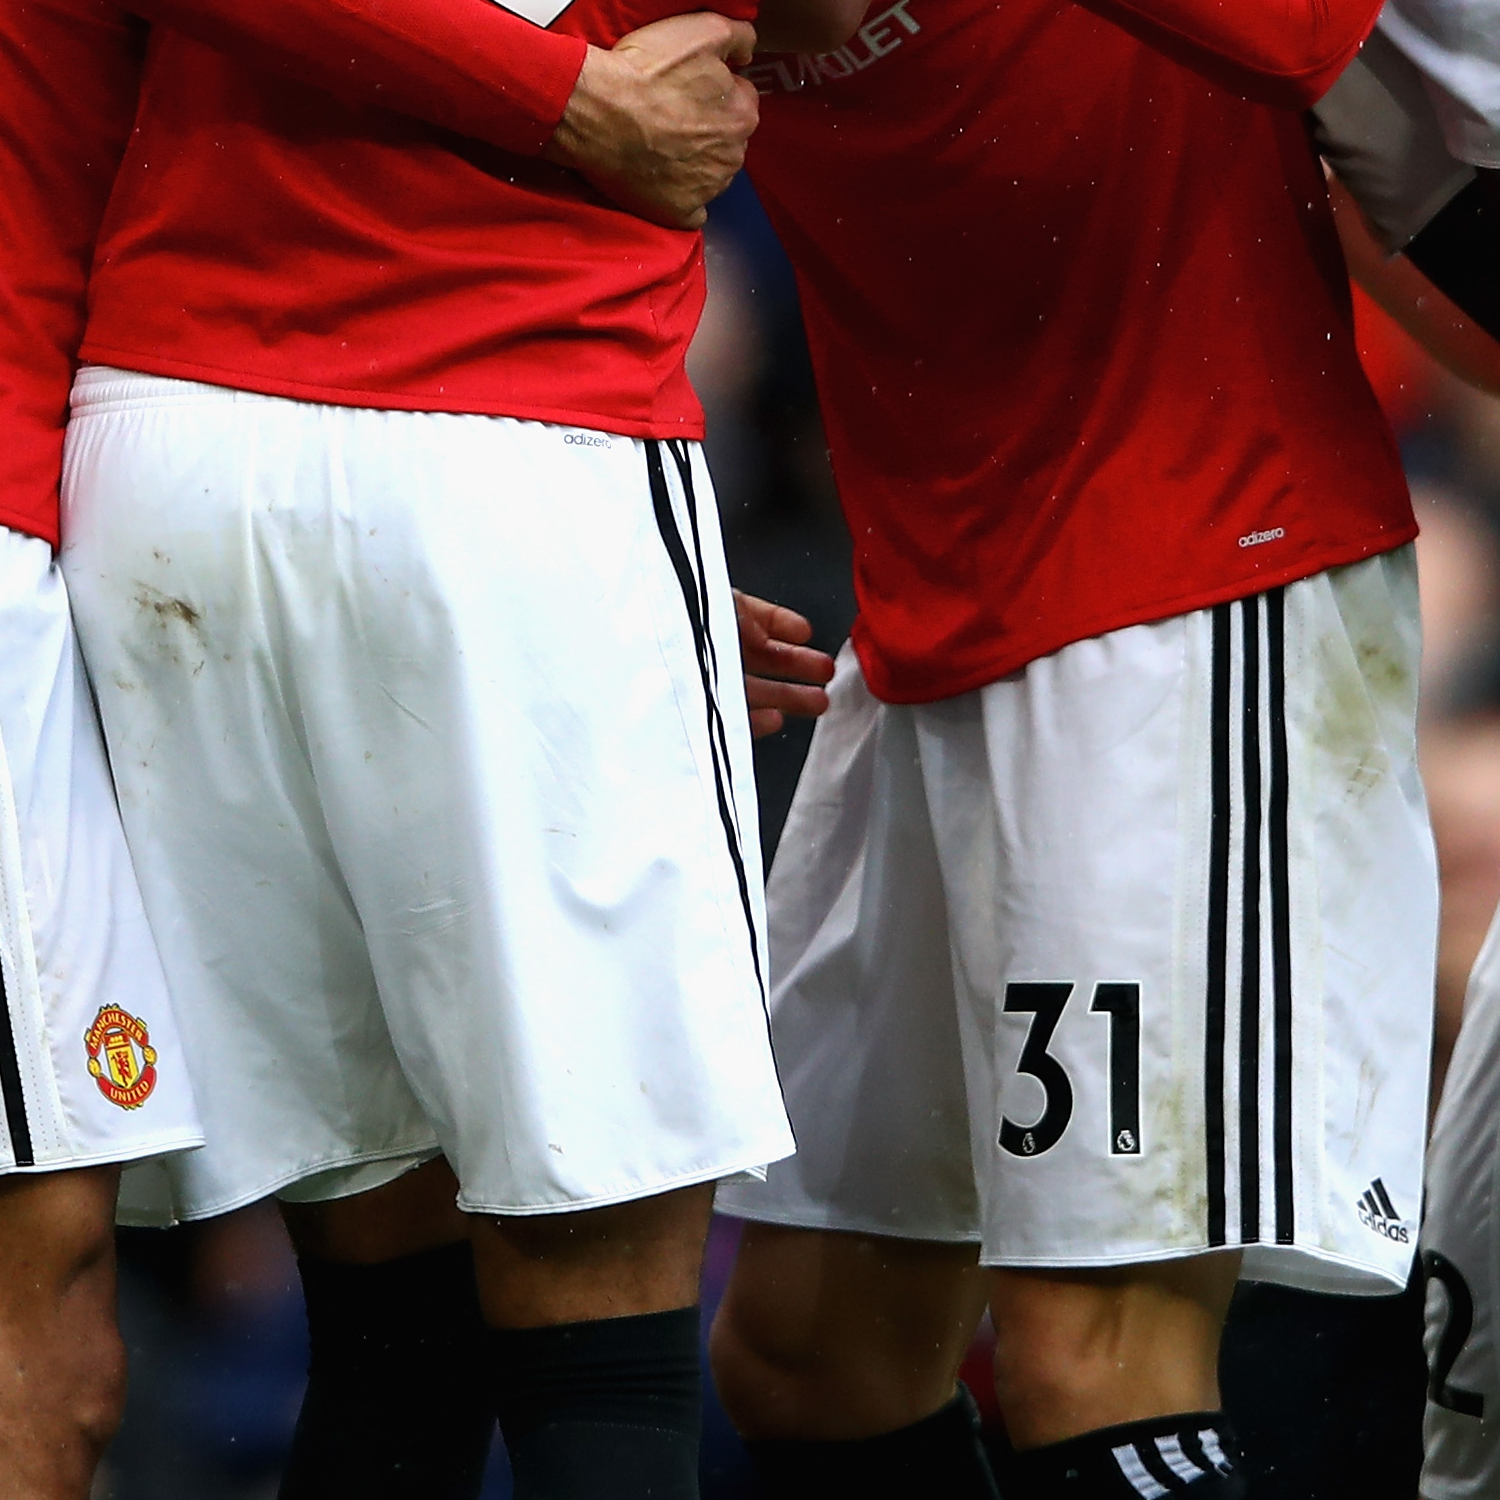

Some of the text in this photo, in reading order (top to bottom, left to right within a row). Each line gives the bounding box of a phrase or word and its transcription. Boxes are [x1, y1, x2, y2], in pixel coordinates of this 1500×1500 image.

[563, 433, 612, 450] adizero
[1238, 527, 1285, 548] adizero
[90, 1012, 144, 1050] MANCHESTER
[998, 980, 1142, 1158] 31
[110, 1081, 150, 1102] UNITED
